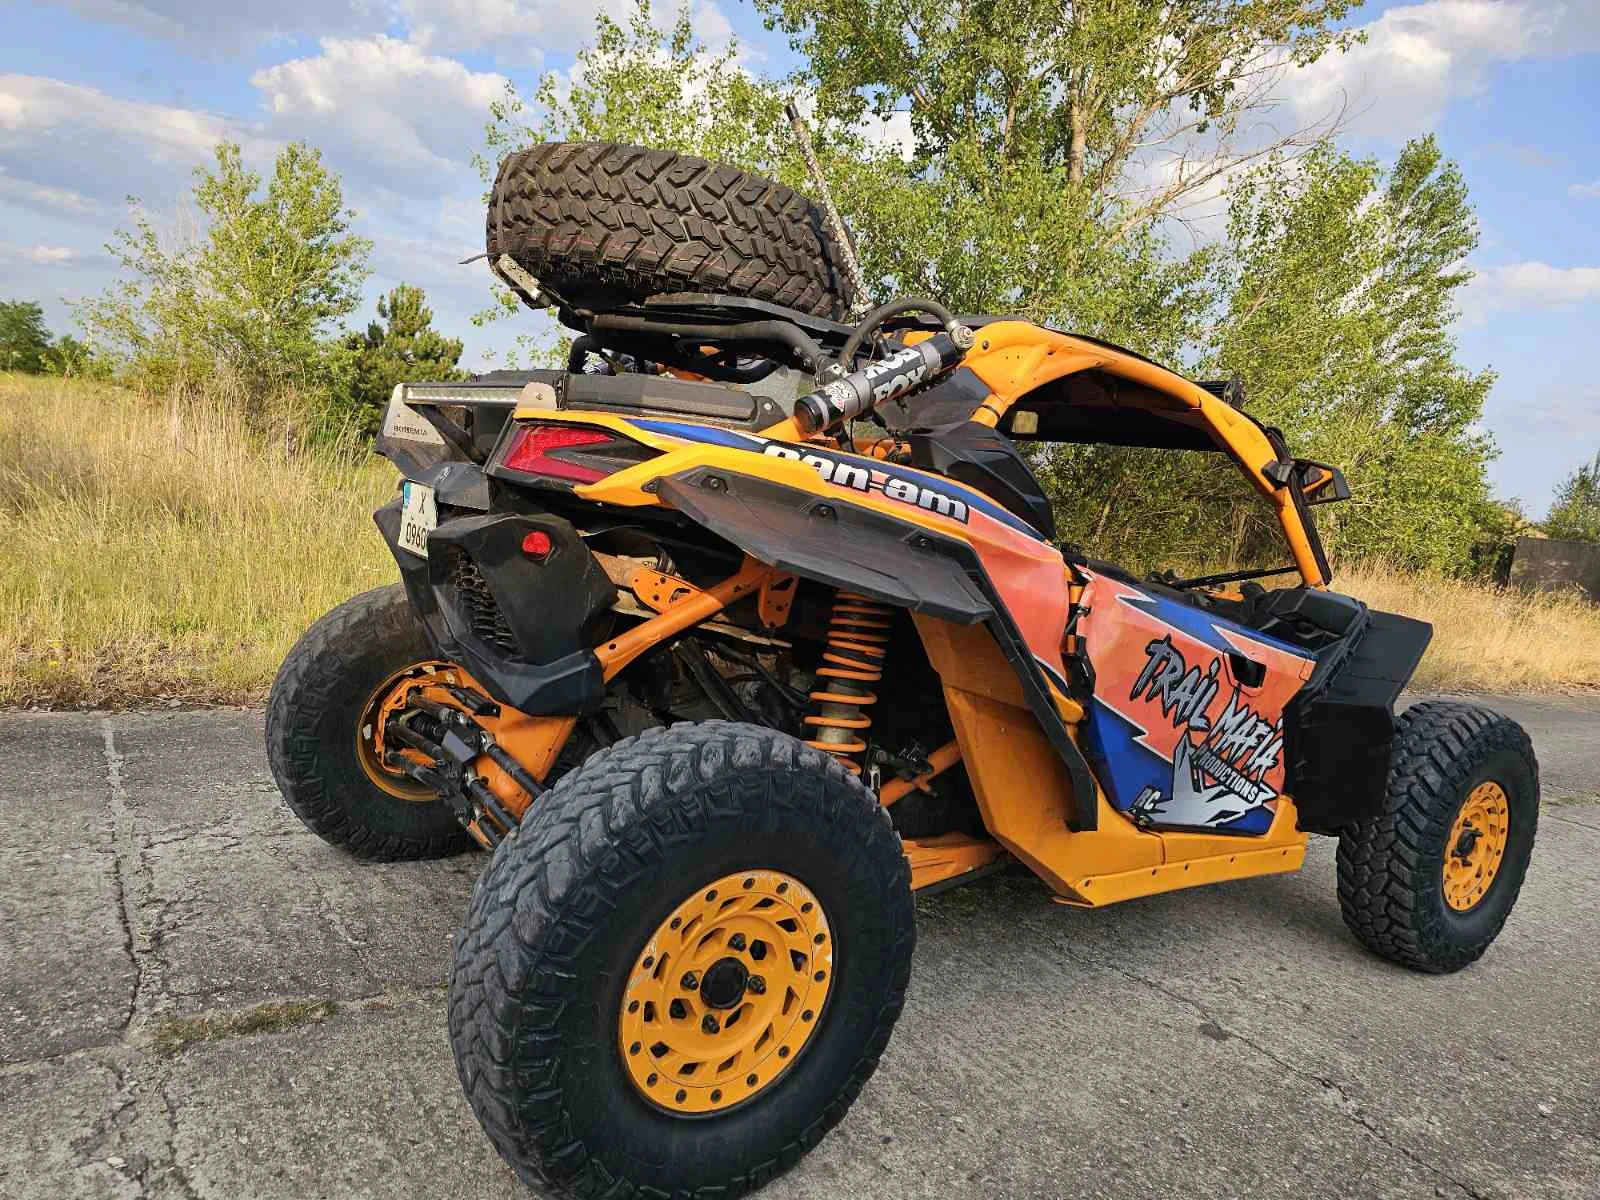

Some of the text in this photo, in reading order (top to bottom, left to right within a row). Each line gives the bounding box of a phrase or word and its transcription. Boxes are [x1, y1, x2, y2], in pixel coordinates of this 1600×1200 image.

[393, 425, 428, 436] BOHEMIA
[405, 522, 430, 550] 0960
[1131, 634, 1283, 781] TRAIL MAFIA
[1196, 747, 1259, 802] PRODUCTIONS
